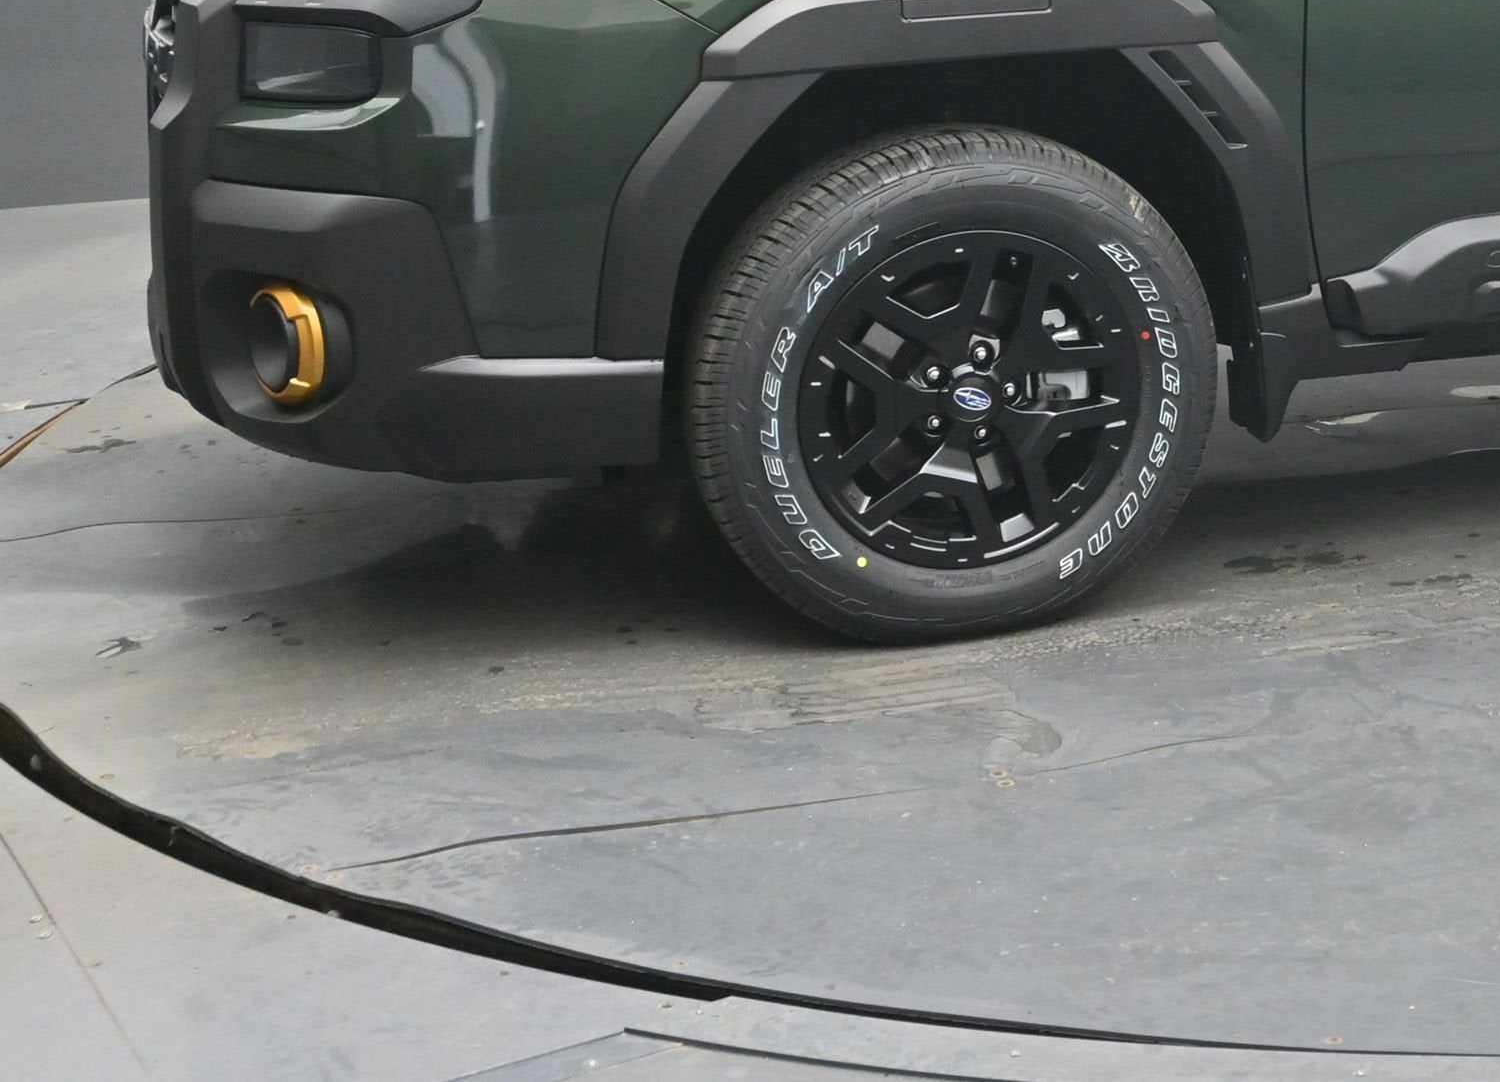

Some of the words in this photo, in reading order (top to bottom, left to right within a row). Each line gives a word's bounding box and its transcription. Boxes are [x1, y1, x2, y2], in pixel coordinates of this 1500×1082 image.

[760, 326, 841, 561] DUELER
[807, 224, 880, 313] A/T
[1059, 242, 1181, 580] BRIDGESTONE
